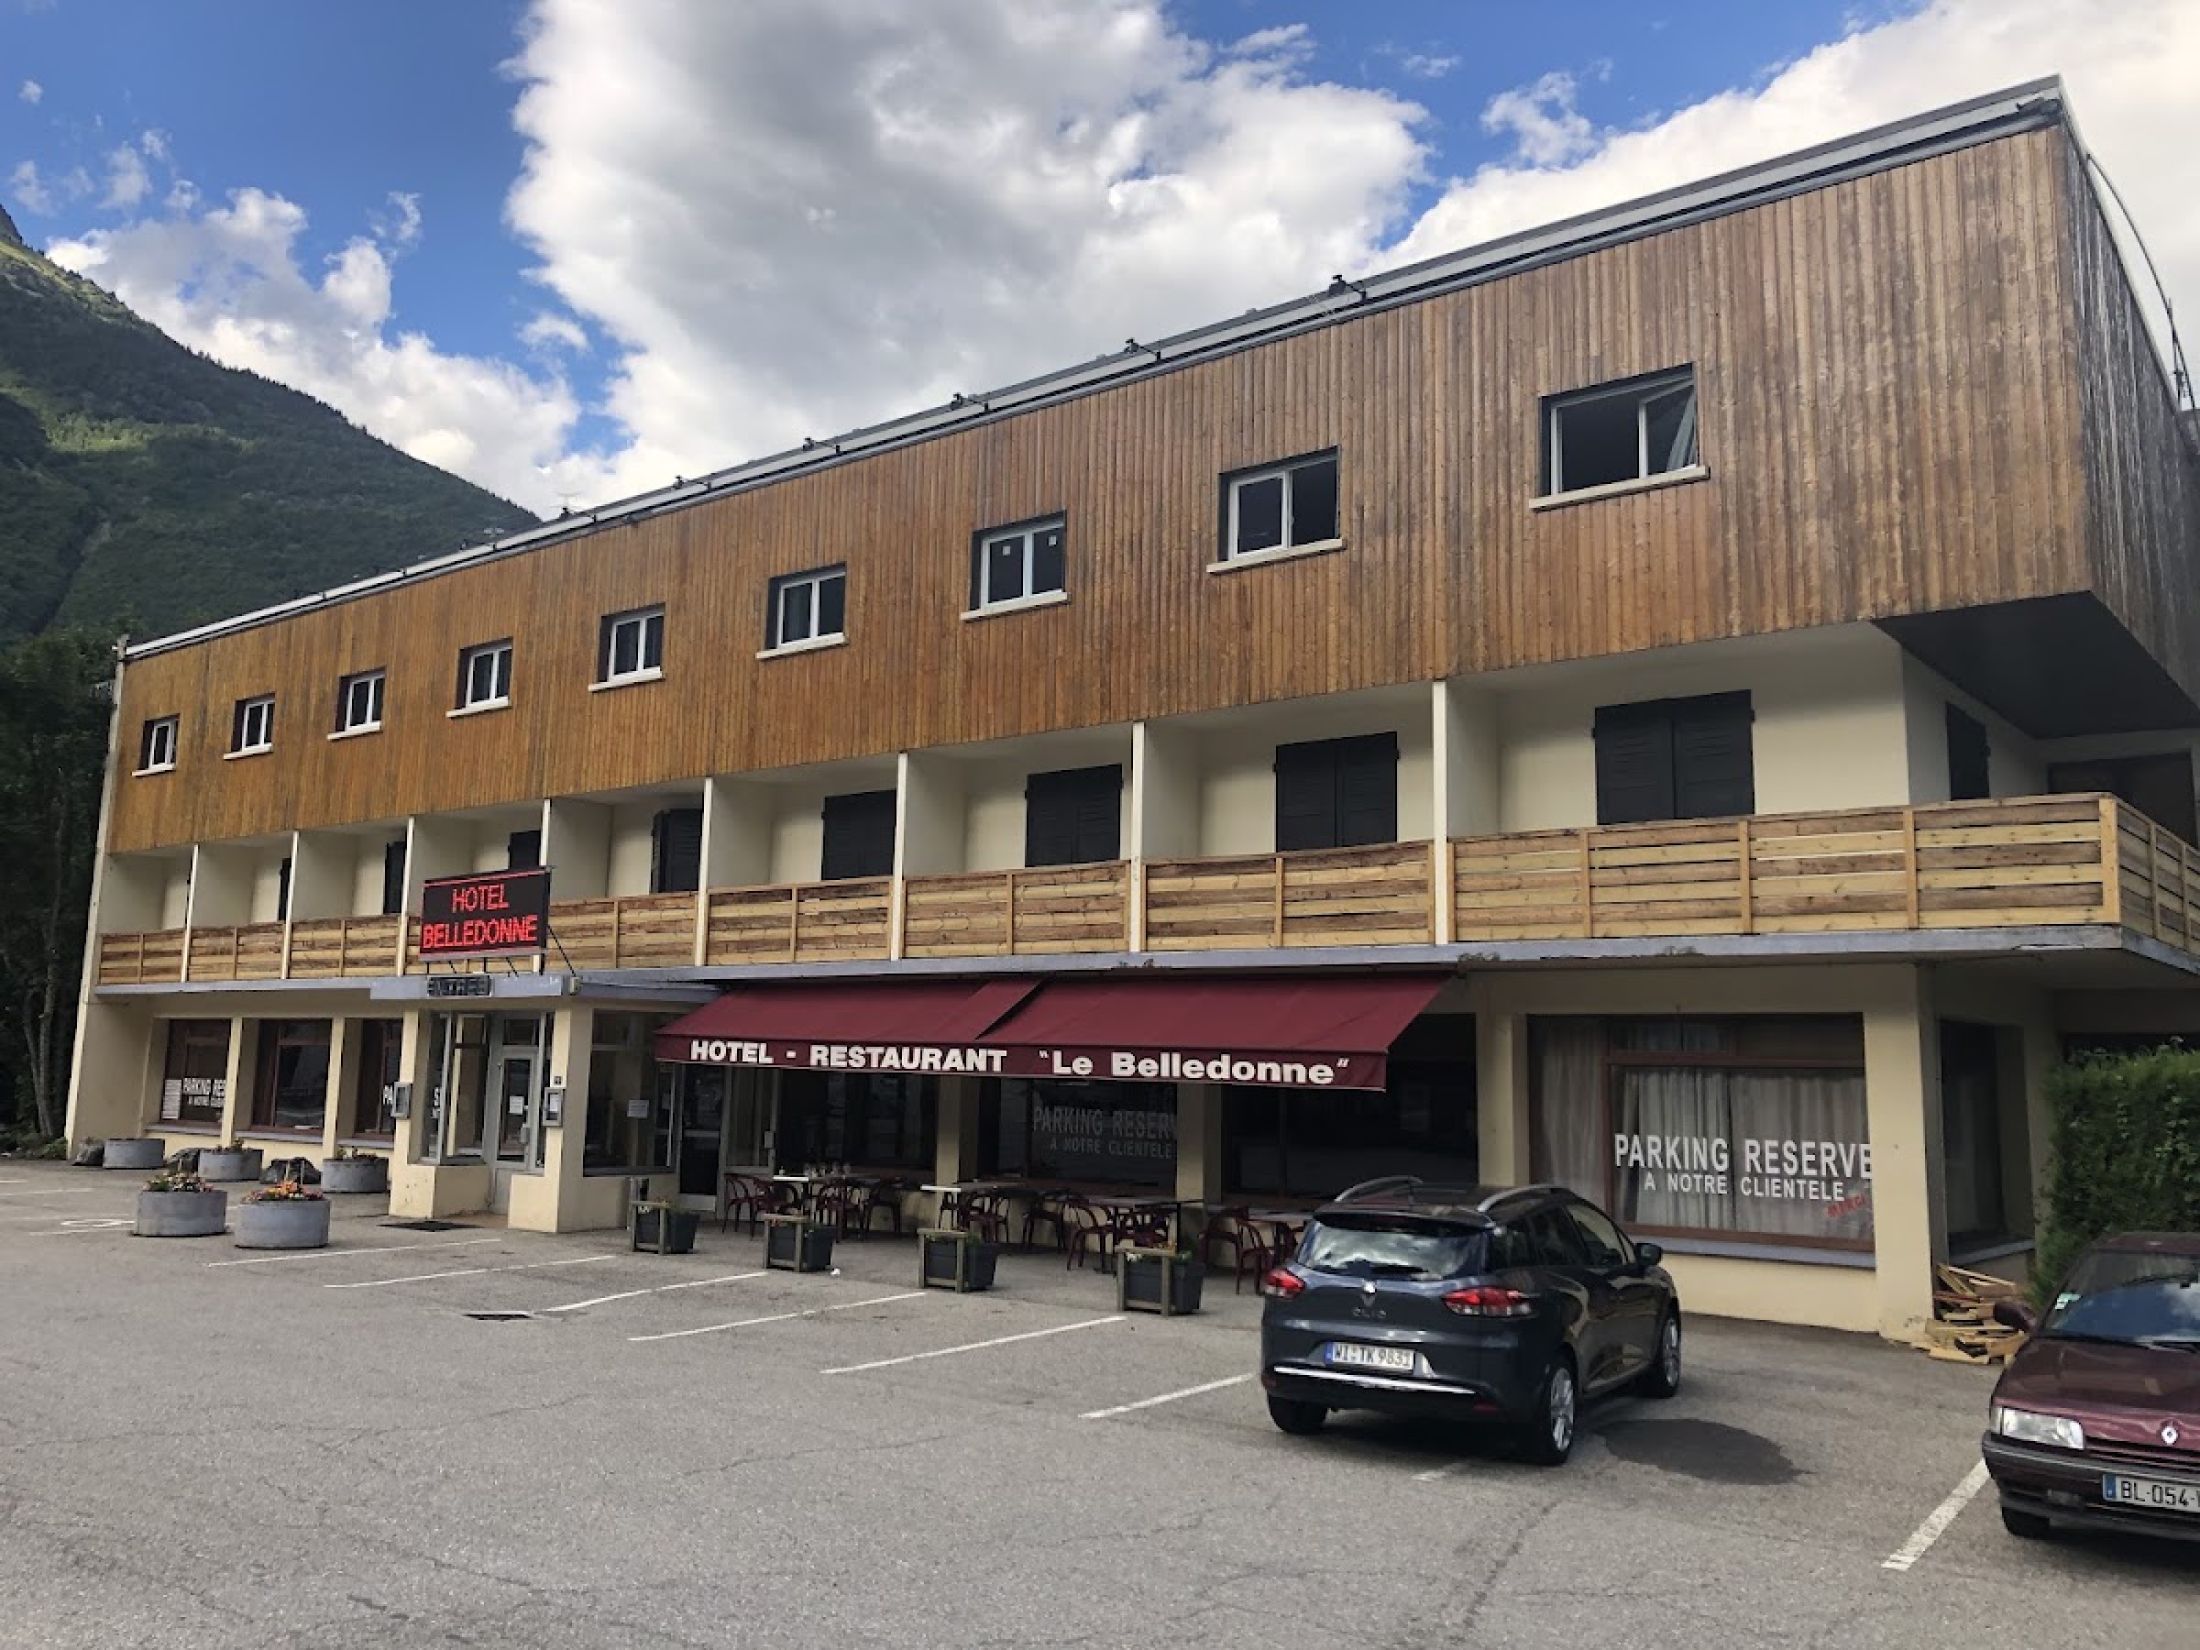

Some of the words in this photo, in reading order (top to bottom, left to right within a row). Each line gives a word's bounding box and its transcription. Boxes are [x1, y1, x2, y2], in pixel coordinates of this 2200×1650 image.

[452, 883, 509, 913] HOTEL
[423, 915, 538, 948] BELLEDONNE
[690, 1040, 774, 1064] HOTEL
[810, 1045, 1007, 1073] RESTAURANT
[1034, 1105, 1103, 1136] PARKING
[1065, 1137, 1101, 1154] NOTRE
[1108, 1140, 1172, 1160] CLIENTELE
[1614, 1133, 1730, 1172] PARKING
[1744, 1138, 1872, 1180] RESERVE
[1644, 1172, 1657, 1191] A
[1667, 1174, 1728, 1194] NOTRE
[1740, 1176, 1845, 1202] CLIENTELE
[2120, 1480, 2200, 1509] BL-054-
